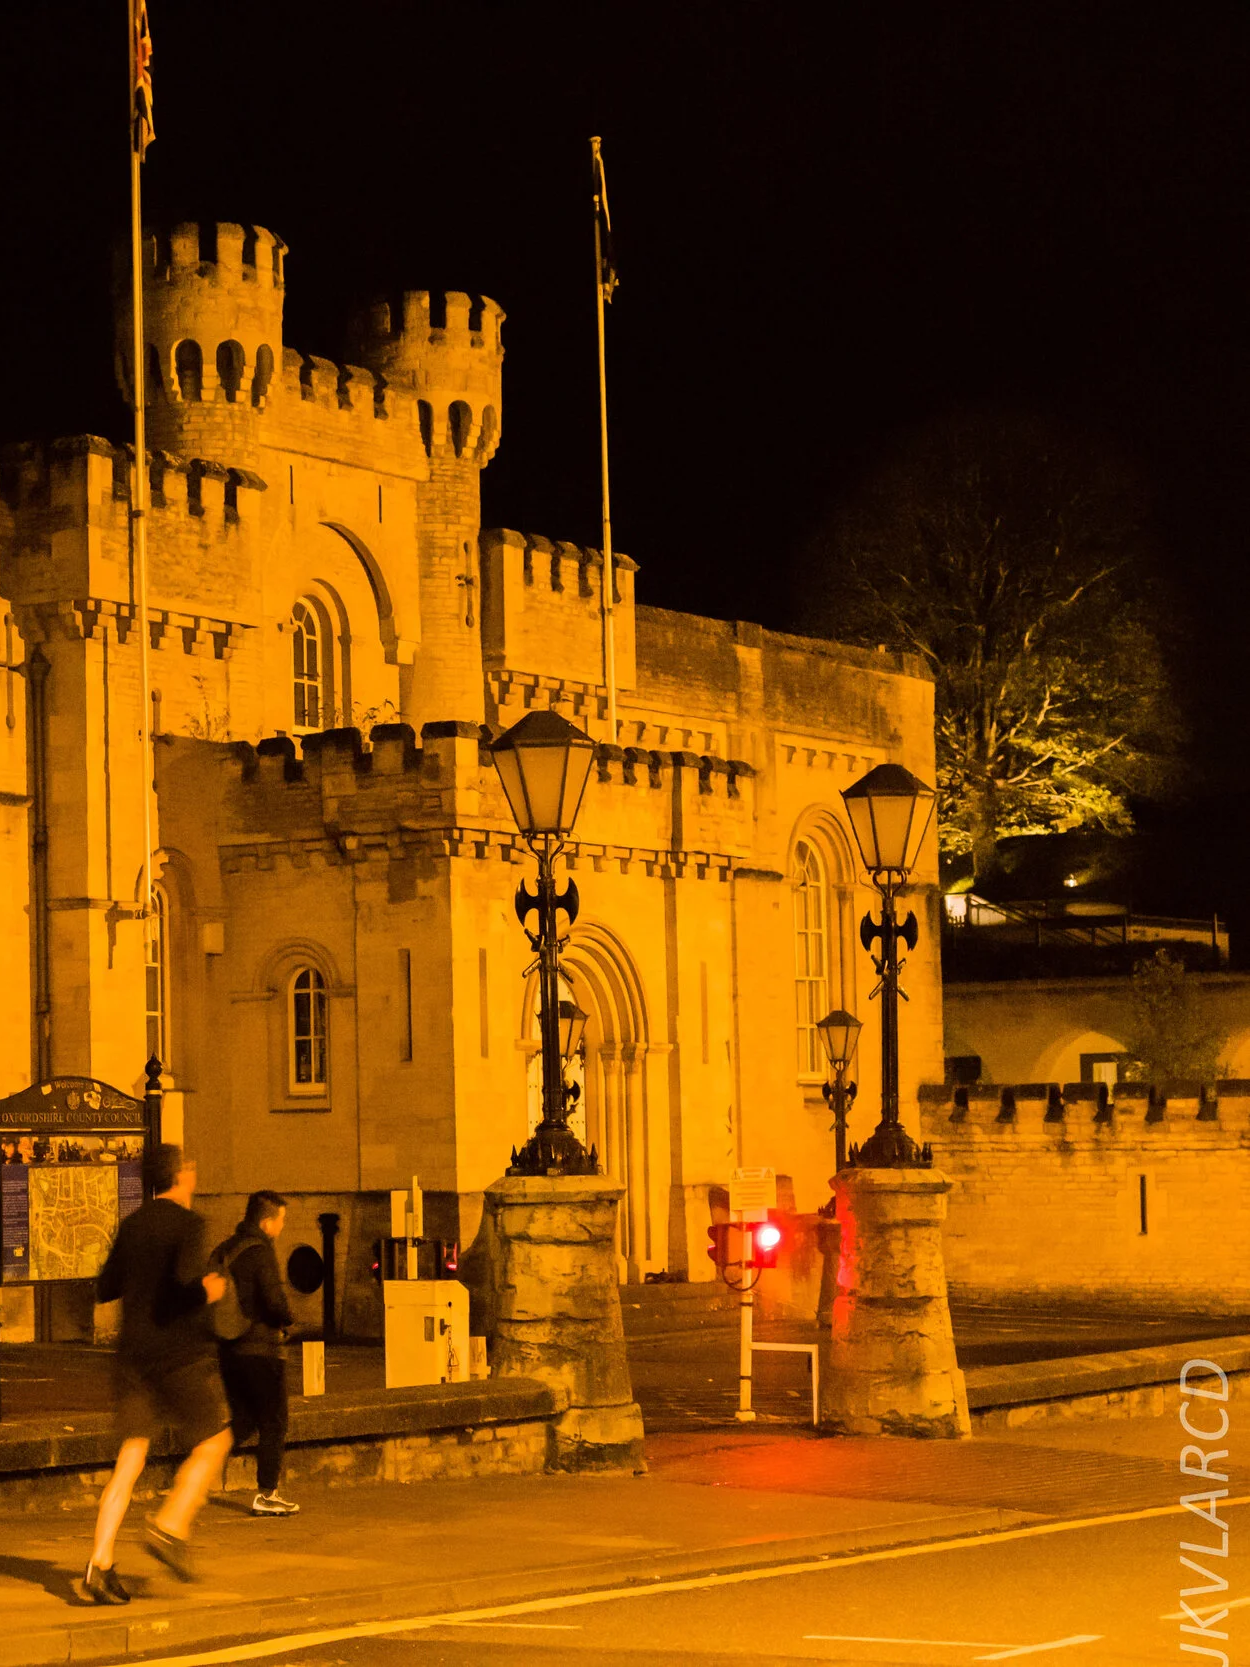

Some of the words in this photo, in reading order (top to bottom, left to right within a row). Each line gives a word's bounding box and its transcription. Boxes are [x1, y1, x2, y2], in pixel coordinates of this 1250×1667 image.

[2, 1112, 64, 1123] OXFORDSHIRE
[66, 1112, 103, 1123] COUNTY
[104, 1112, 143, 1123] COUNCIL
